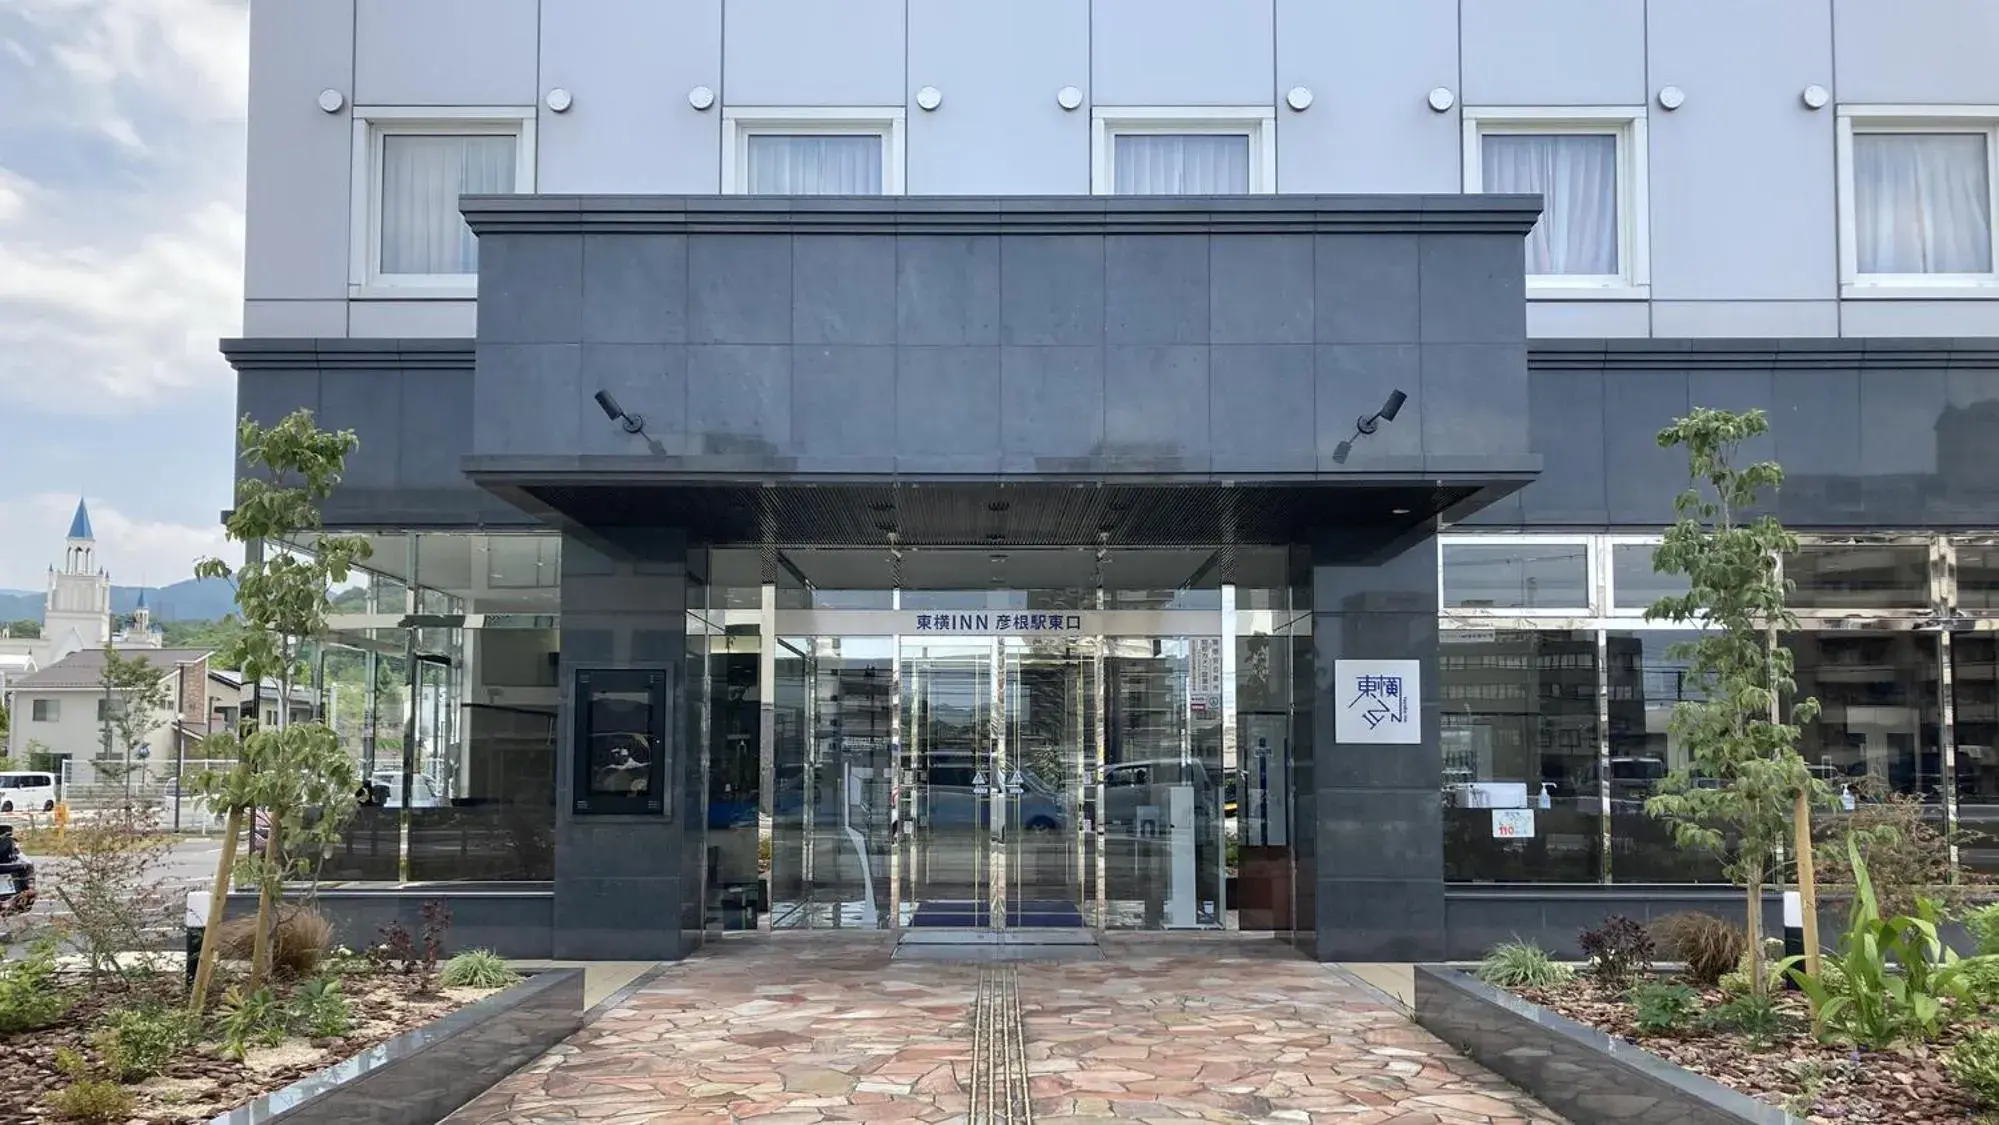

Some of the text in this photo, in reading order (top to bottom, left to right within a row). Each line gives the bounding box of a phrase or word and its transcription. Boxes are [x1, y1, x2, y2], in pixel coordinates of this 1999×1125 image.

[916, 614, 1081, 631] 東横INN 彦根駅東口
